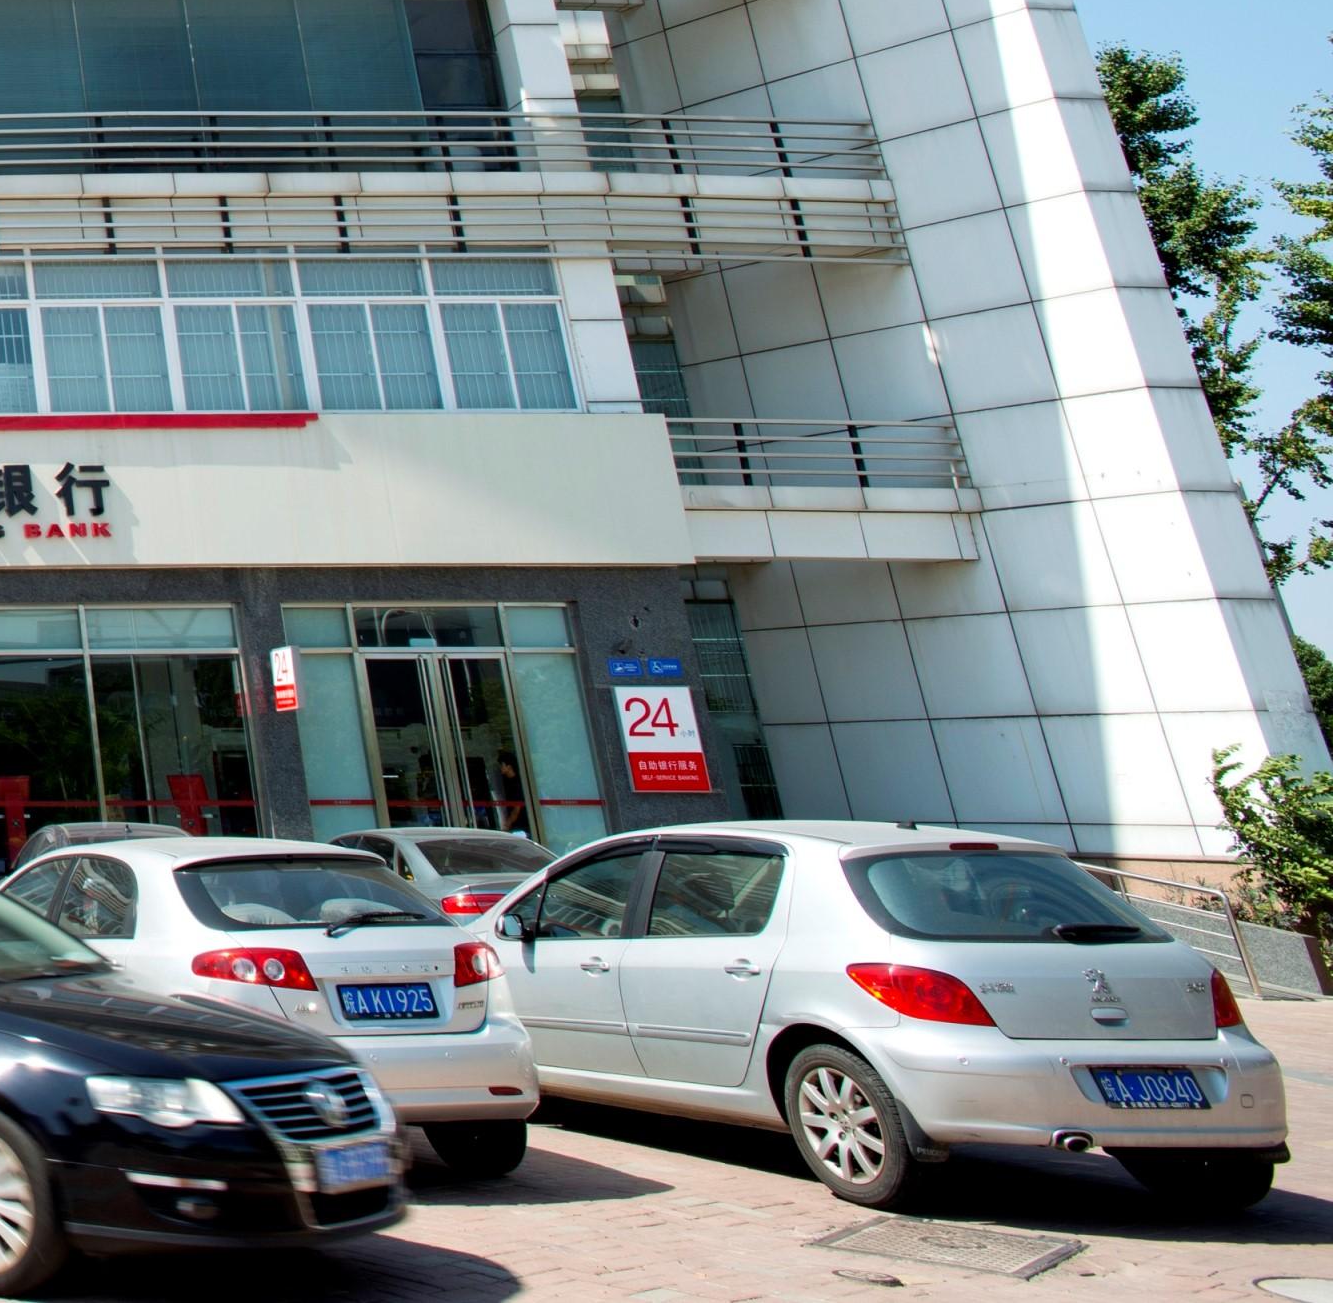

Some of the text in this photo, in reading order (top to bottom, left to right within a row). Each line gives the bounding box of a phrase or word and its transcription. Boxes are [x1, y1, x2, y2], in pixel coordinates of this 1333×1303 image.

[22, 521, 113, 539] BANK
[274, 650, 289, 682] 24
[624, 697, 679, 737] 24
[638, 760, 698, 771] 自助银行服务
